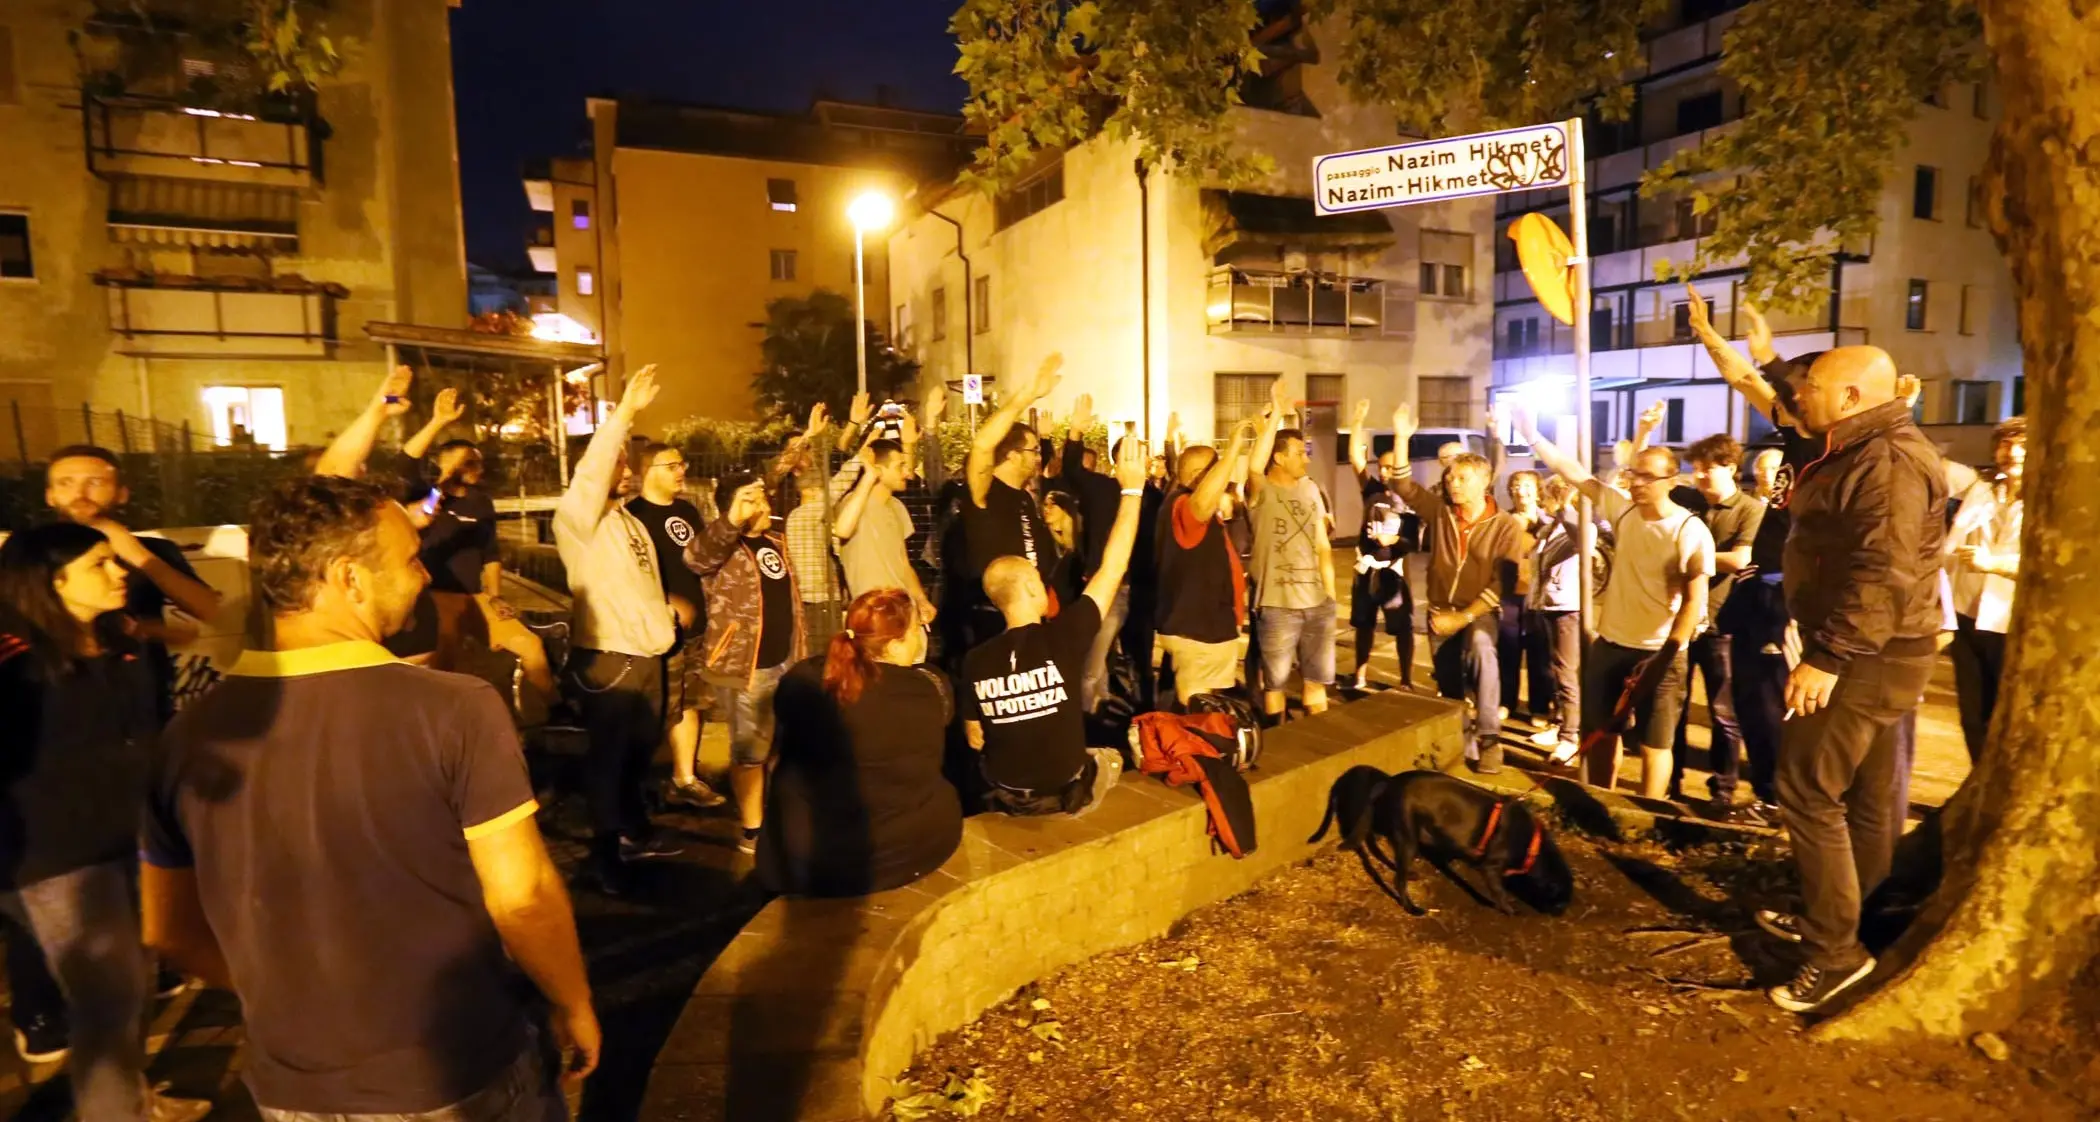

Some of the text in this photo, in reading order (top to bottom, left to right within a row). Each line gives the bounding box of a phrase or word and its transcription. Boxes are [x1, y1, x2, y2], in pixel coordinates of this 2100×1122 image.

[1327, 135, 1553, 181] passaggio Nazim Hikmet
[1328, 168, 1488, 204] Nazim-Hikmet
[974, 660, 1065, 700] VOLONTÀ
[995, 687, 1068, 715] POTENZA
